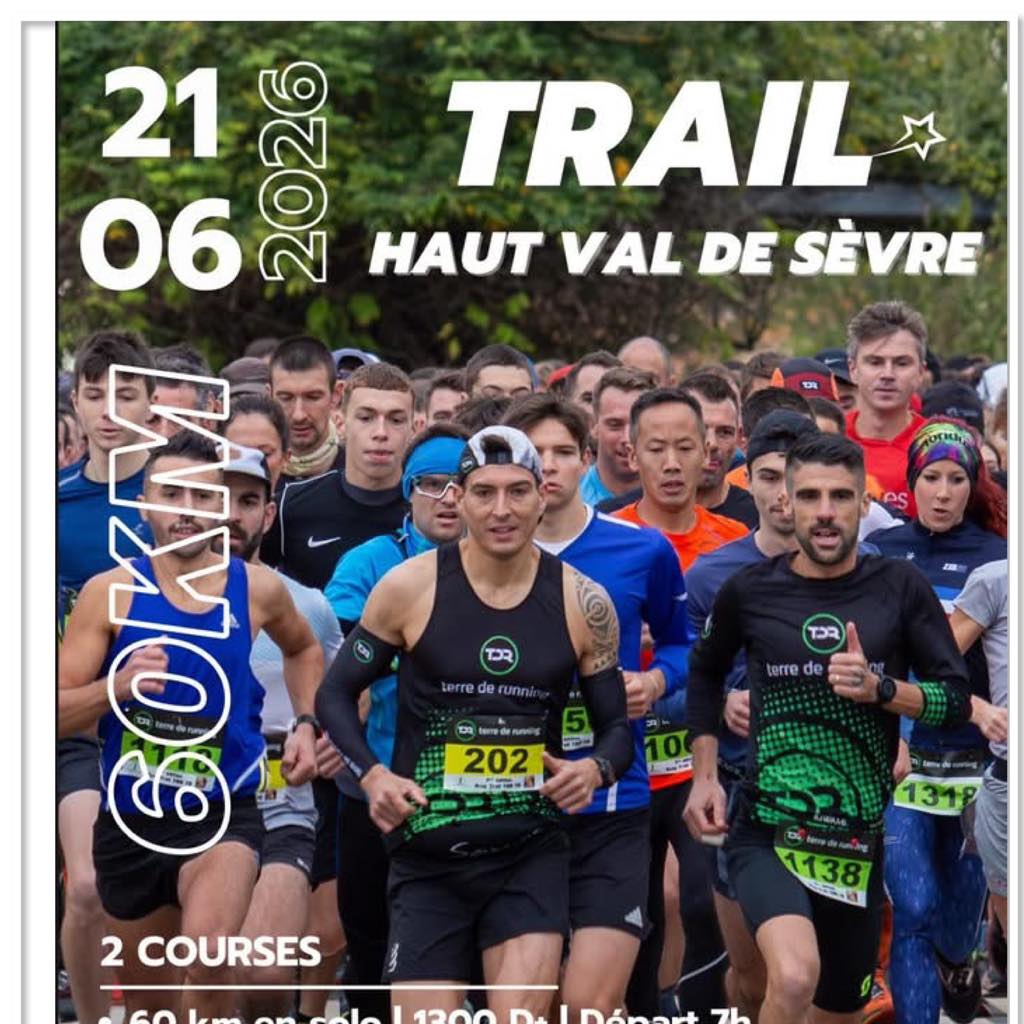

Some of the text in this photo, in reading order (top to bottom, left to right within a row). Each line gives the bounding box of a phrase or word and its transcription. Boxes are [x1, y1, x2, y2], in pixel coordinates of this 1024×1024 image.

[102, 66, 219, 159] 21
[447, 80, 874, 187] TRAIL
[259, 60, 329, 284] 2026
[79, 198, 243, 291] 06
[369, 218, 984, 276] HAUT VAL DE SÈVRE
[107, 363, 231, 855] 60KM
[441, 681, 474, 694] terre
[477, 681, 495, 694] de
[766, 661, 823, 677] terre de
[463, 748, 530, 774] 202
[784, 852, 863, 887] 1138
[101, 936, 321, 967] 2 COURSES
